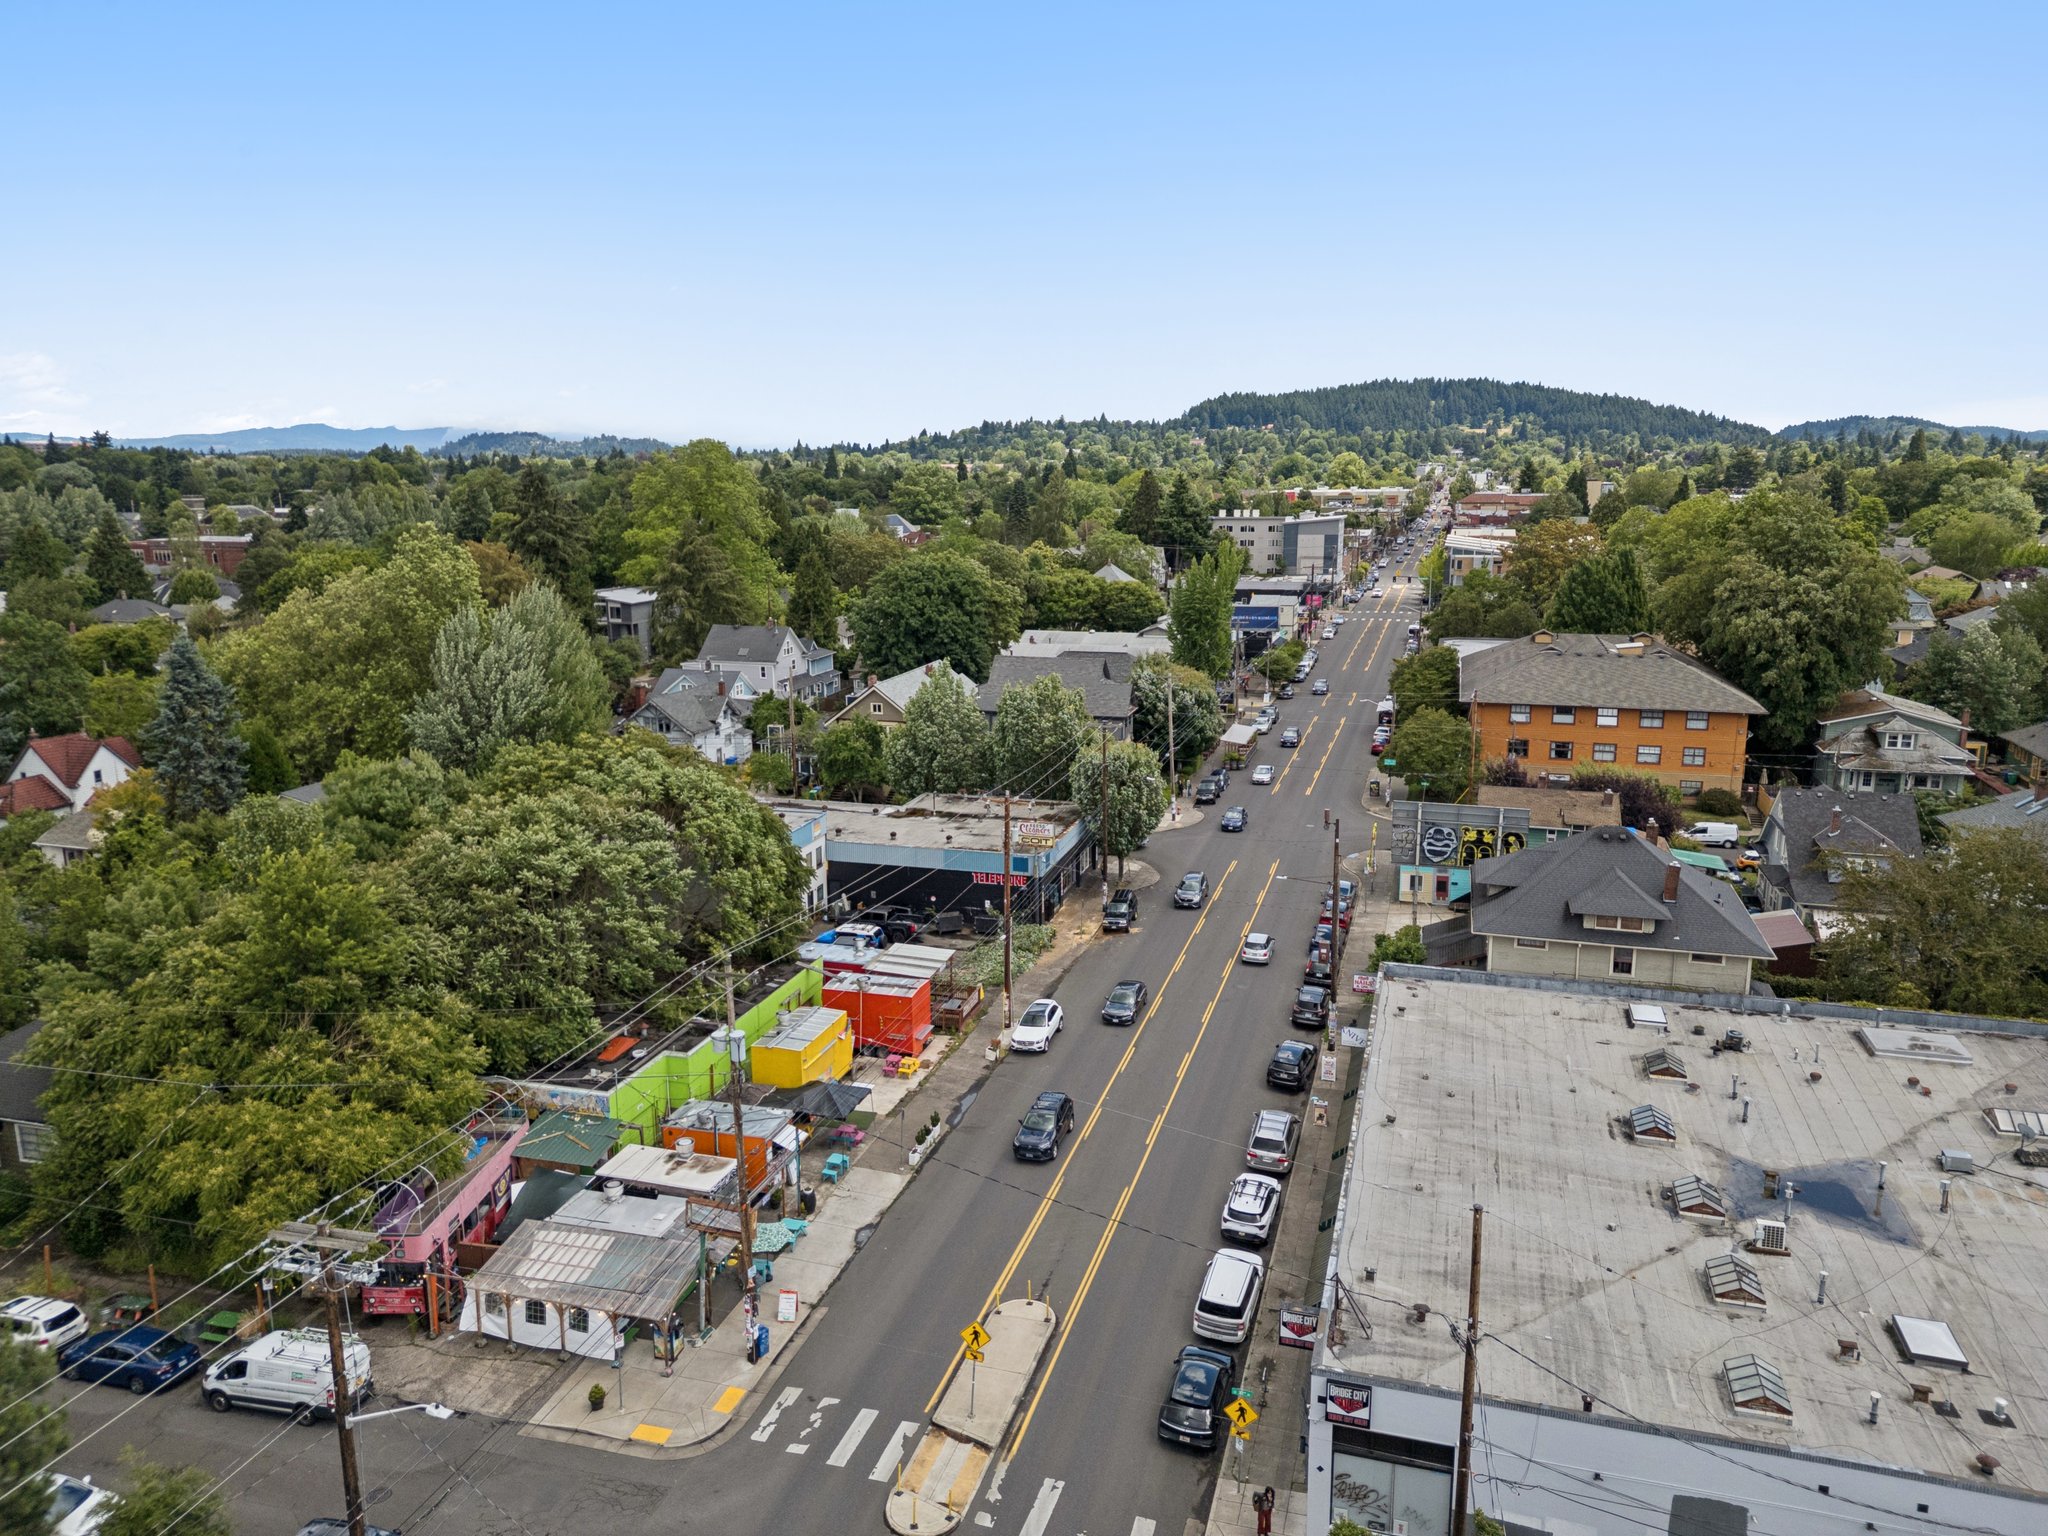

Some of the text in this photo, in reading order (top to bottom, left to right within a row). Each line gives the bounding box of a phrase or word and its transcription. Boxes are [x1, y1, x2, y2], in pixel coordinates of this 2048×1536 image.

[1021, 837, 1050, 845] COIT
[1282, 1311, 1318, 1327] BRIDGE CITY
[1330, 1385, 1368, 1403] BRIDGE CITY
